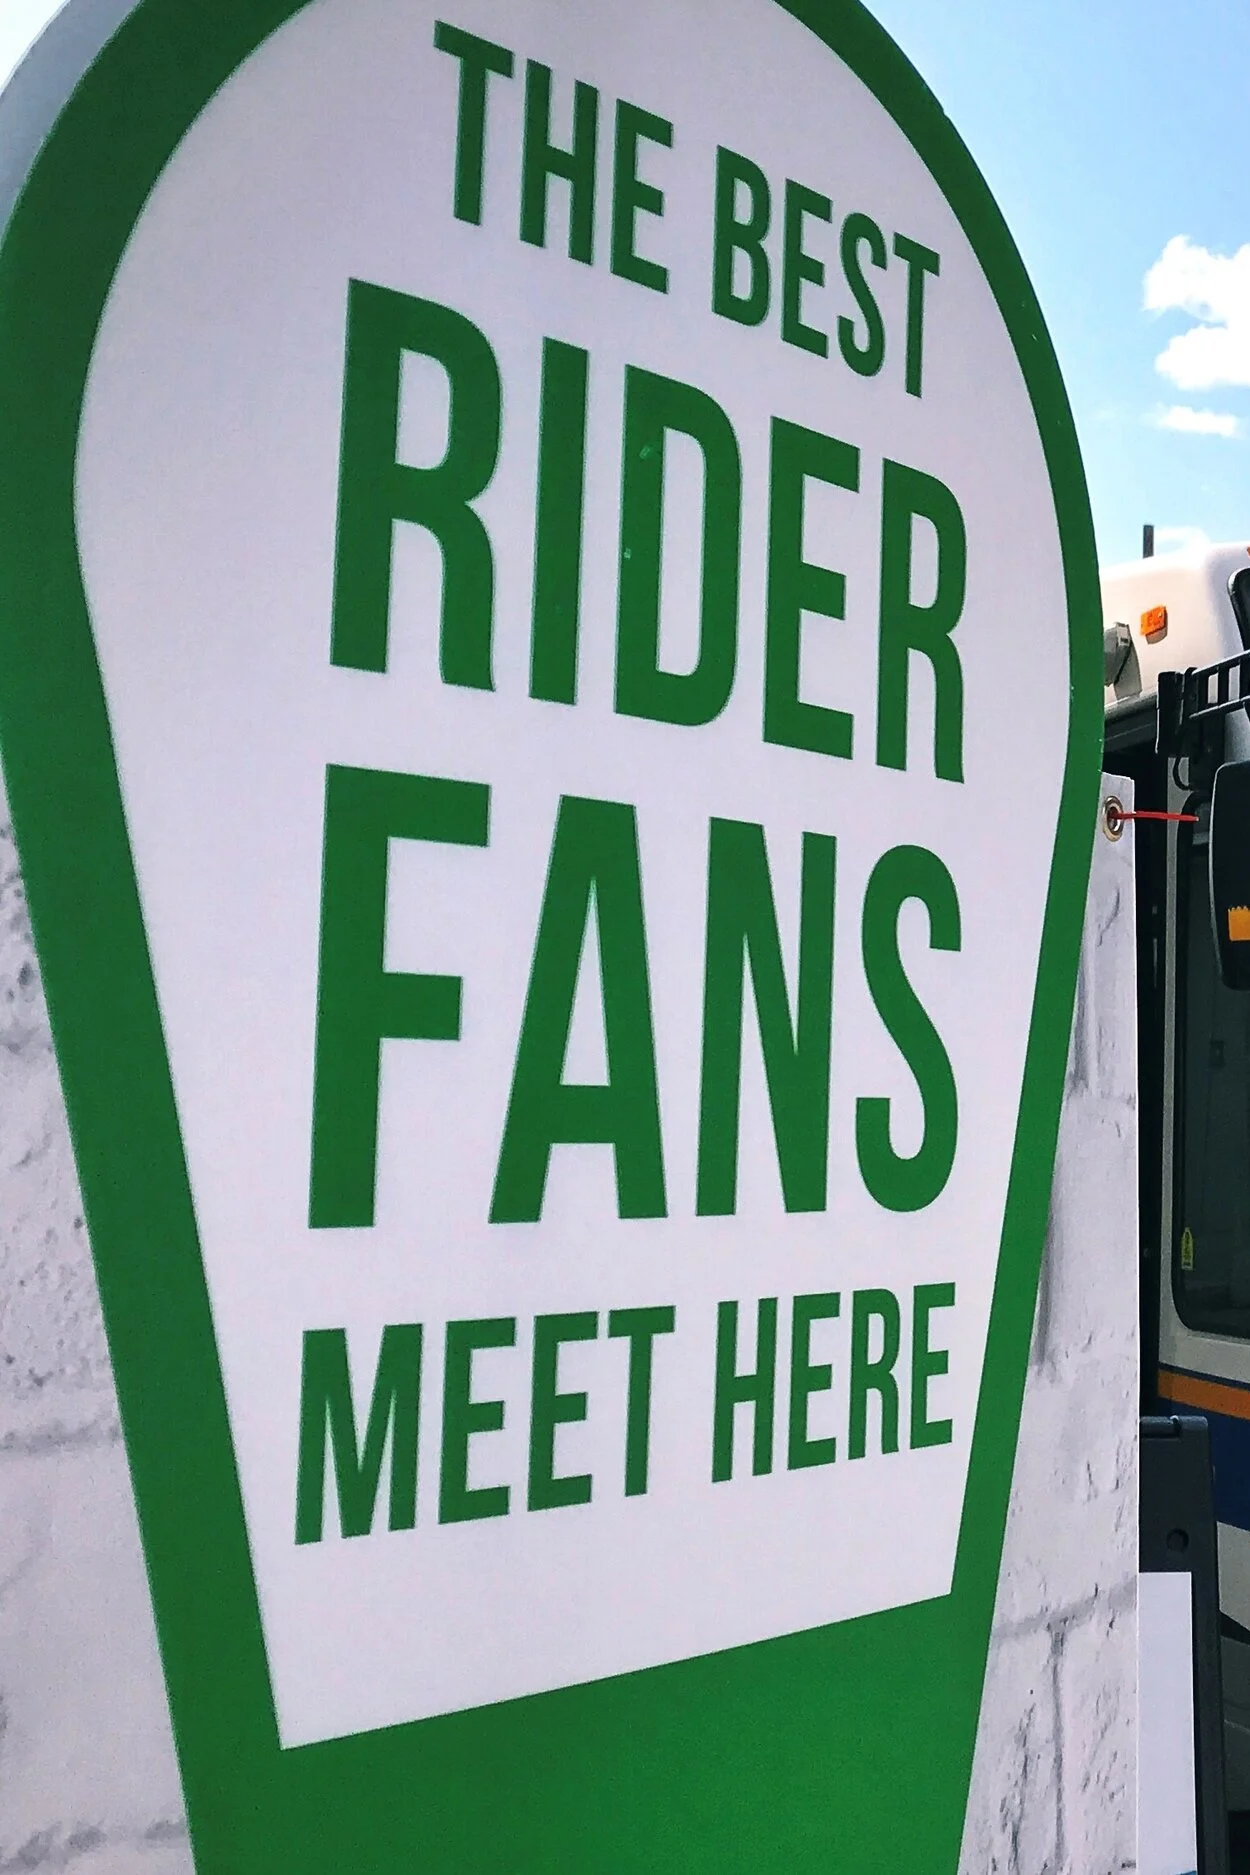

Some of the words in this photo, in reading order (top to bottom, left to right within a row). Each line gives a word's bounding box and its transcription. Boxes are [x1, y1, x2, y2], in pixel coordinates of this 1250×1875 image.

[433, 20, 674, 294] THE
[710, 145, 940, 398] BEST
[330, 278, 967, 784] RIDER
[309, 763, 964, 1229] FANS
[295, 1305, 676, 1545] MEET
[712, 1282, 957, 1483] HERE
